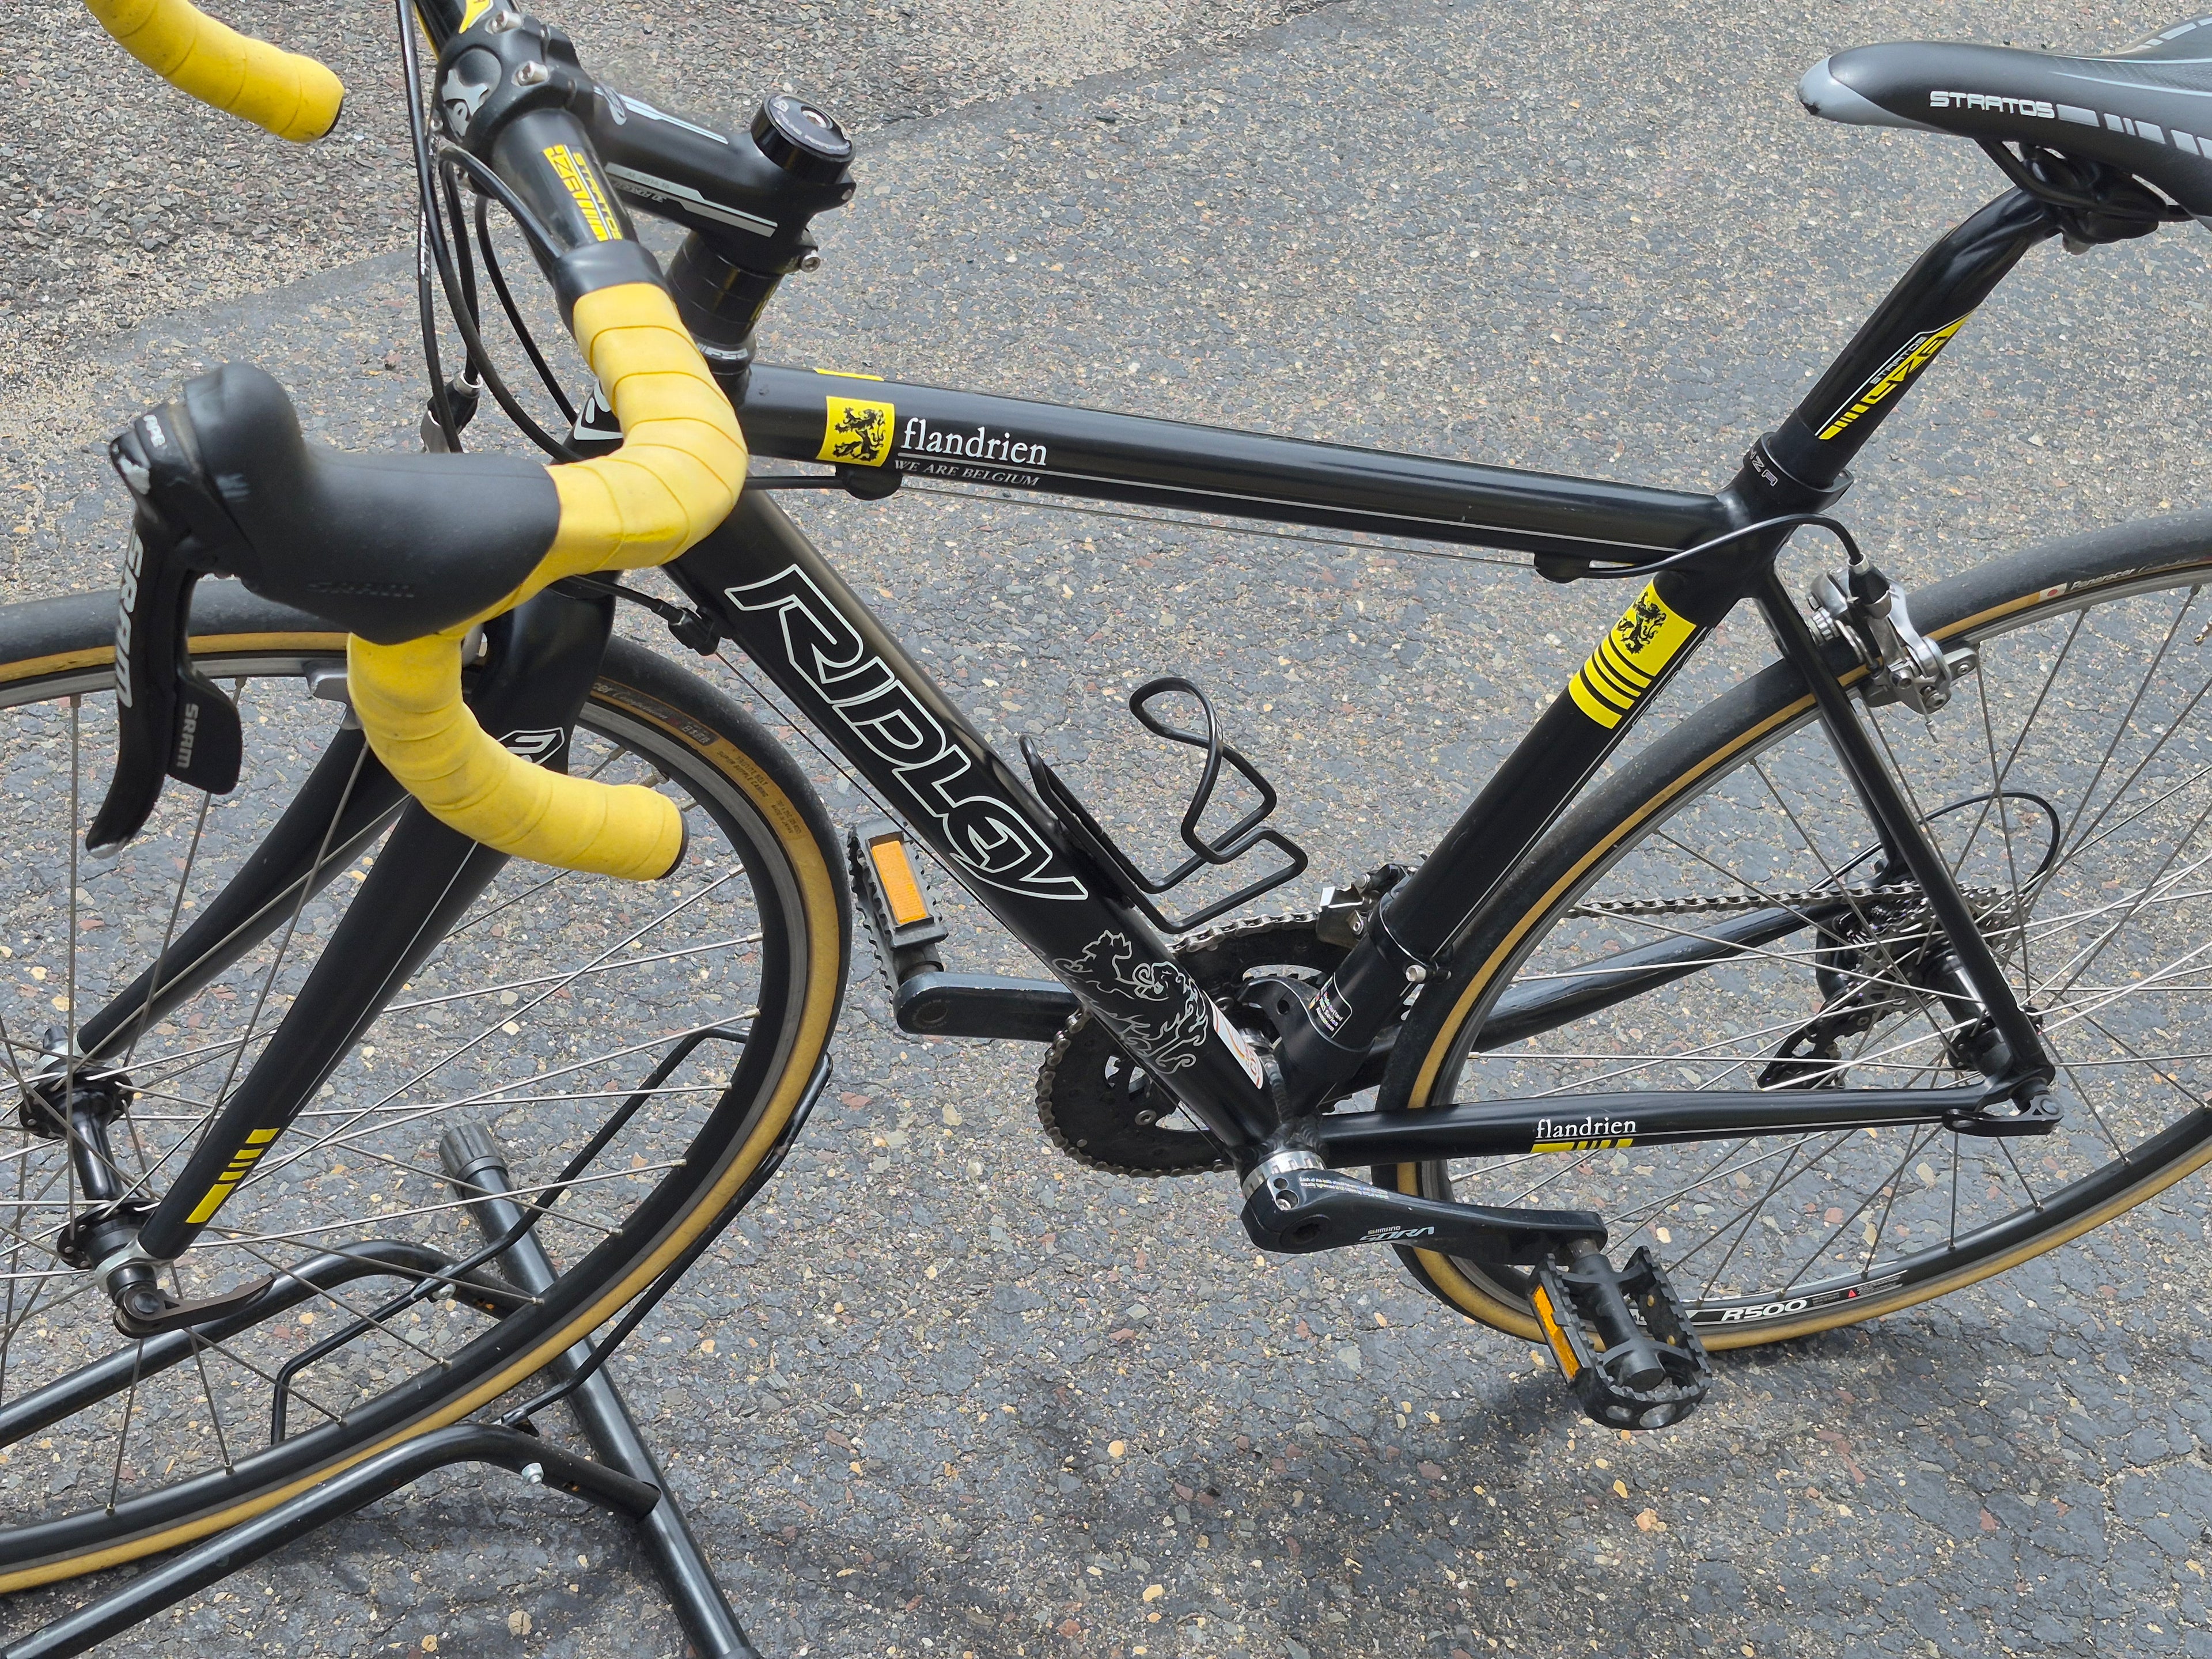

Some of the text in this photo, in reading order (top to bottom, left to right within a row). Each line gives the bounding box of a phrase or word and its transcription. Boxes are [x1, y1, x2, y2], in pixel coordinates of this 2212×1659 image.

[1930, 91, 2055, 119] STRATOS
[573, 152, 623, 240] STRATOS
[1870, 336, 1927, 385] STRATOS
[900, 418, 1048, 466] flandrien
[895, 459, 1041, 487] WE ARE BELGIUM
[2071, 568, 2136, 590] Panaracer
[115, 527, 144, 709] SRAM
[176, 703, 199, 769] SRAM
[724, 563, 1089, 900] RIDLEY
[1536, 1116, 1637, 1139] flandrien
[1355, 1226, 1434, 1244] SORA
[1368, 1225, 1401, 1235] SHIMANO
[1720, 1298, 1808, 1322] R500
